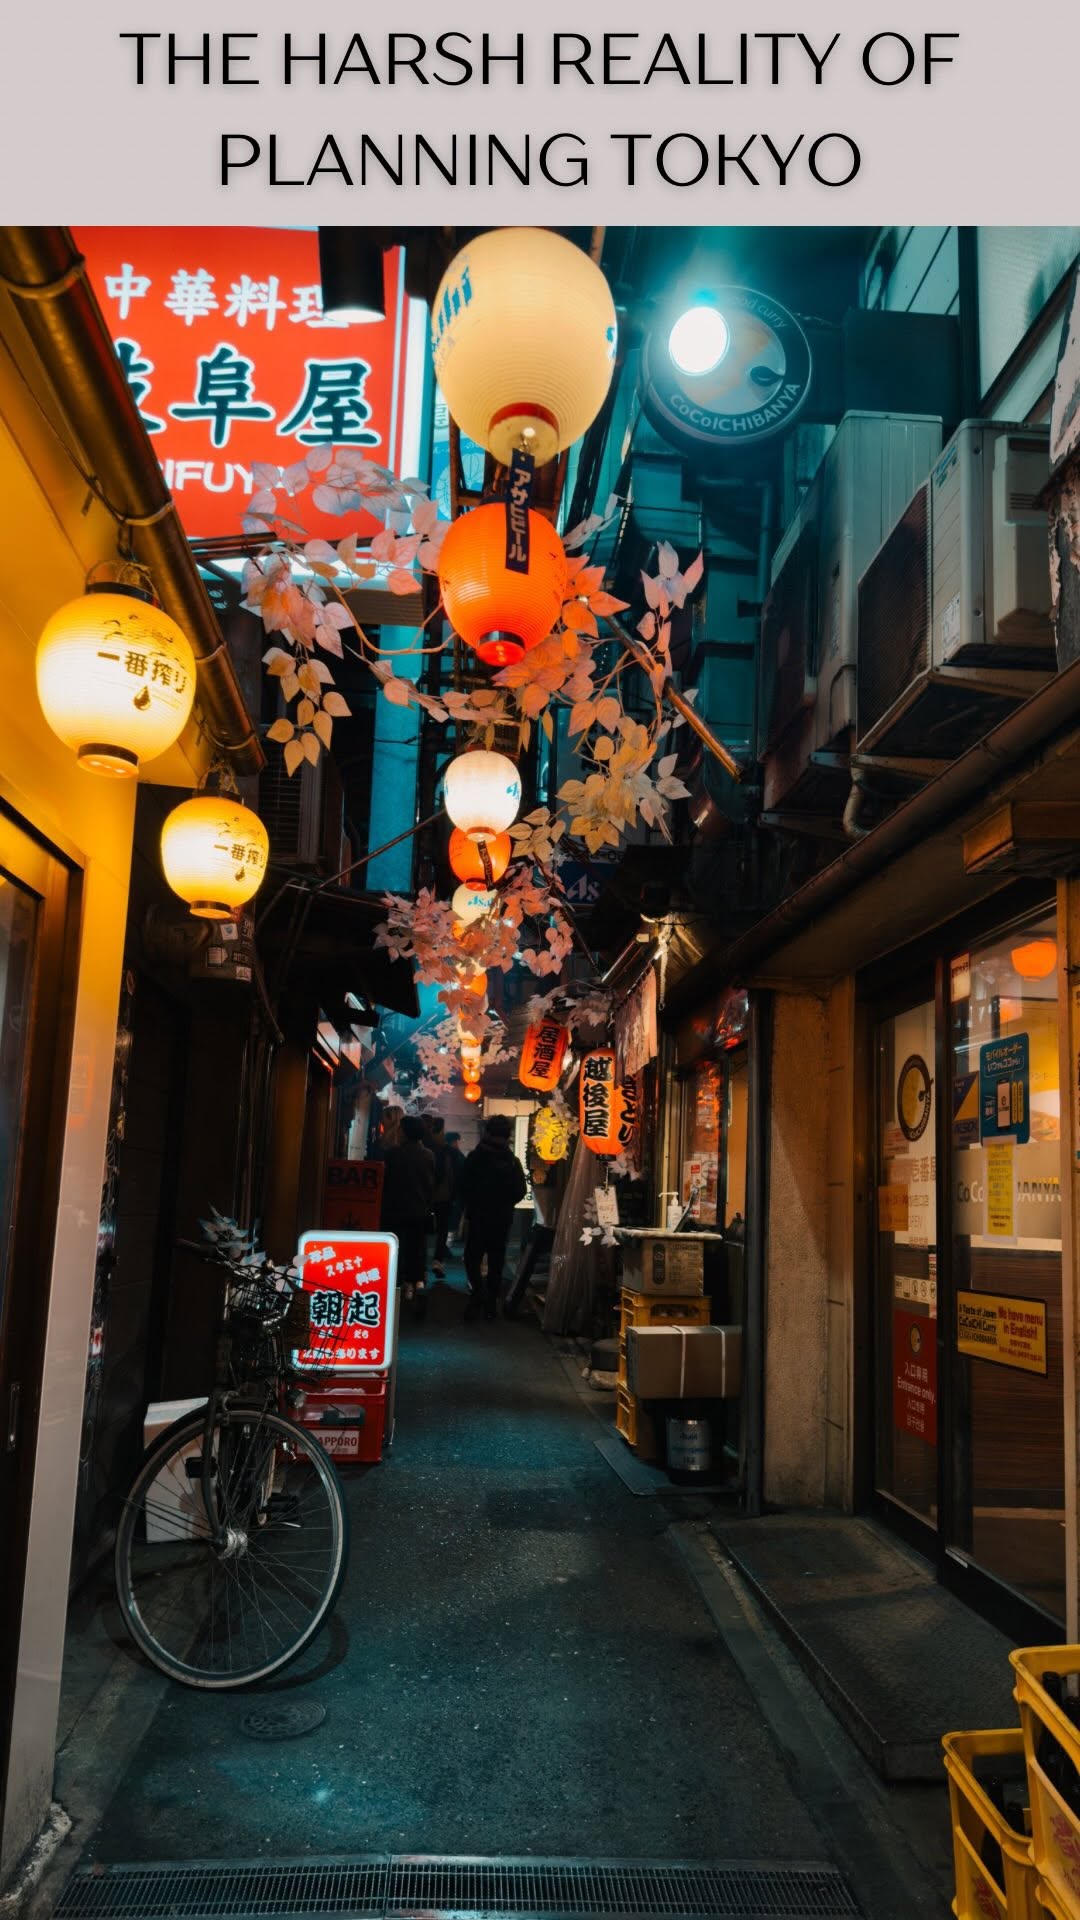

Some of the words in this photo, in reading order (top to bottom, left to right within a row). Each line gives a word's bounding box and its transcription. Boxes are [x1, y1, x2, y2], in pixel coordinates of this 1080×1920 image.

[670, 382, 800, 432] CoCoICHIBANYA
[159, 459, 296, 497] IFUY
[97, 650, 188, 694] 一番搾り
[530, 1025, 561, 1080] 居酒屋
[582, 1055, 613, 1138] 越後屋
[328, 1166, 377, 1187] BAR
[325, 1256, 363, 1278] スタミナ
[310, 1290, 380, 1327] 朝起
[1023, 1313, 1043, 1327] menu
[897, 1376, 922, 1398] Entrance
[318, 1436, 358, 1447] APPORO
